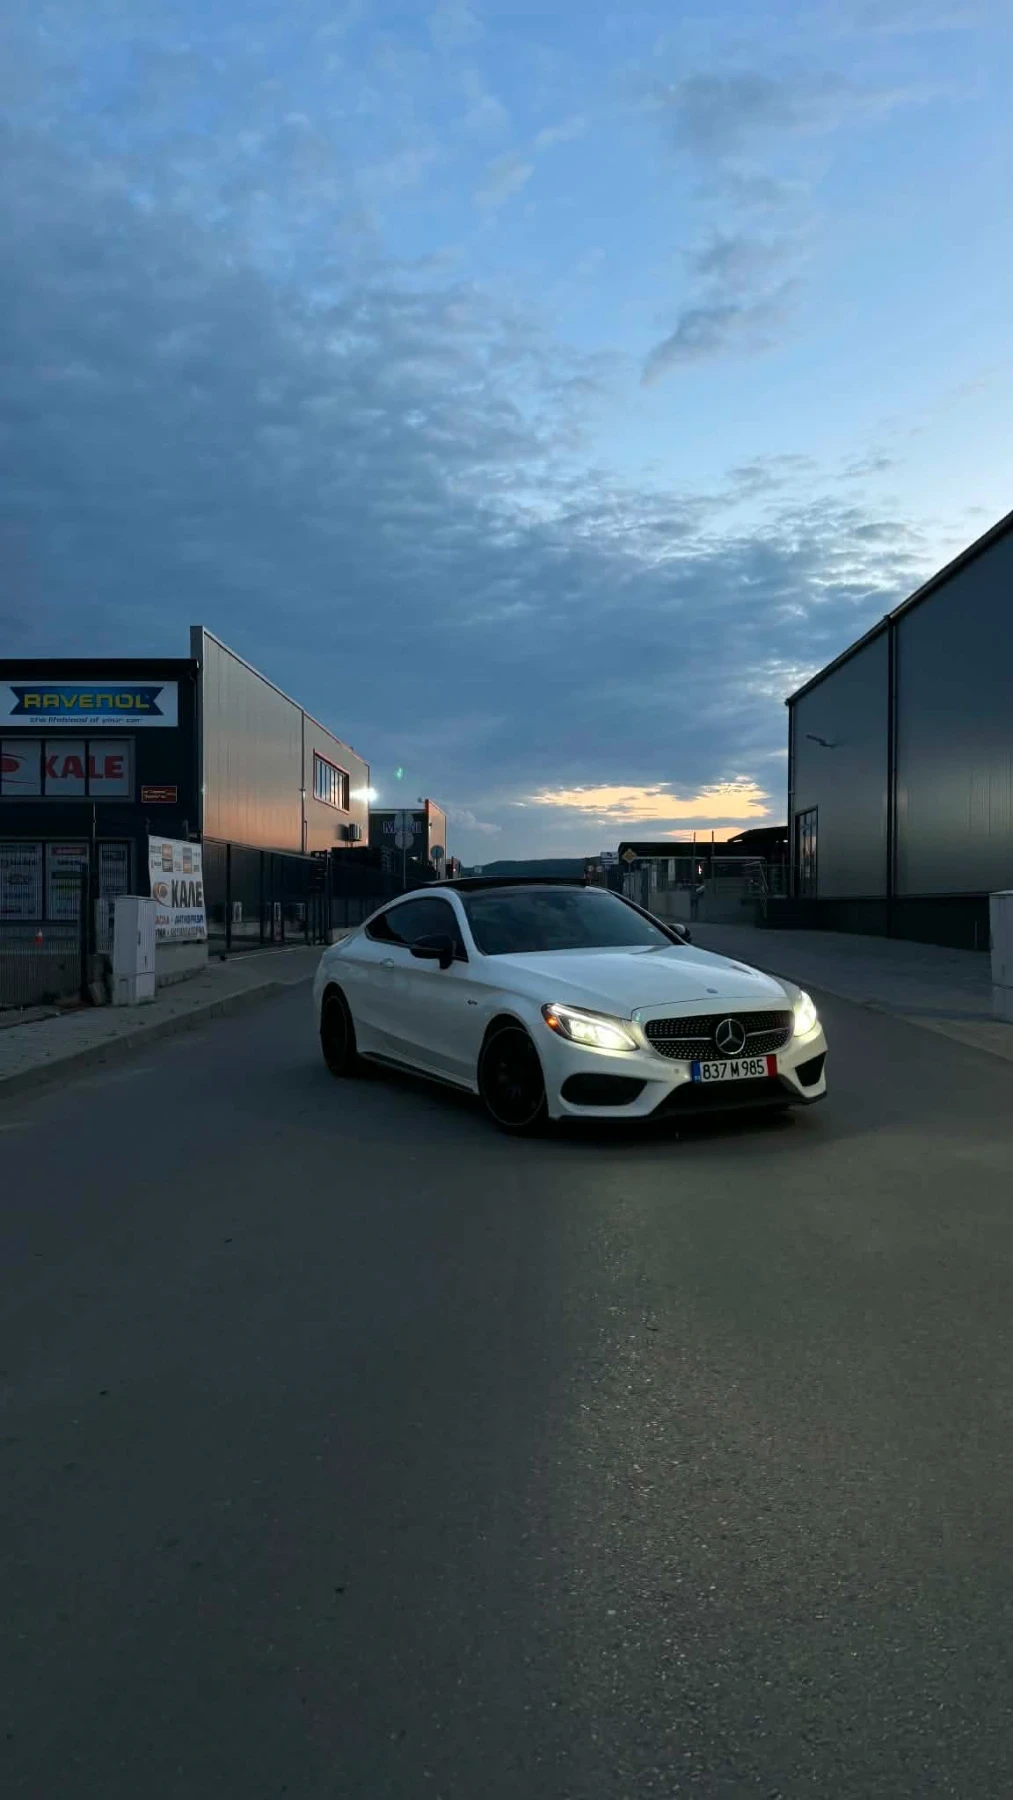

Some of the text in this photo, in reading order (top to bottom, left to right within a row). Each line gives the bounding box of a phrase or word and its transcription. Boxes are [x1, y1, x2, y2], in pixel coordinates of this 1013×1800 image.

[24, 693, 149, 708] RAVENOL
[44, 755, 124, 779] KALE
[703, 1059, 765, 1080] 837 M 985
